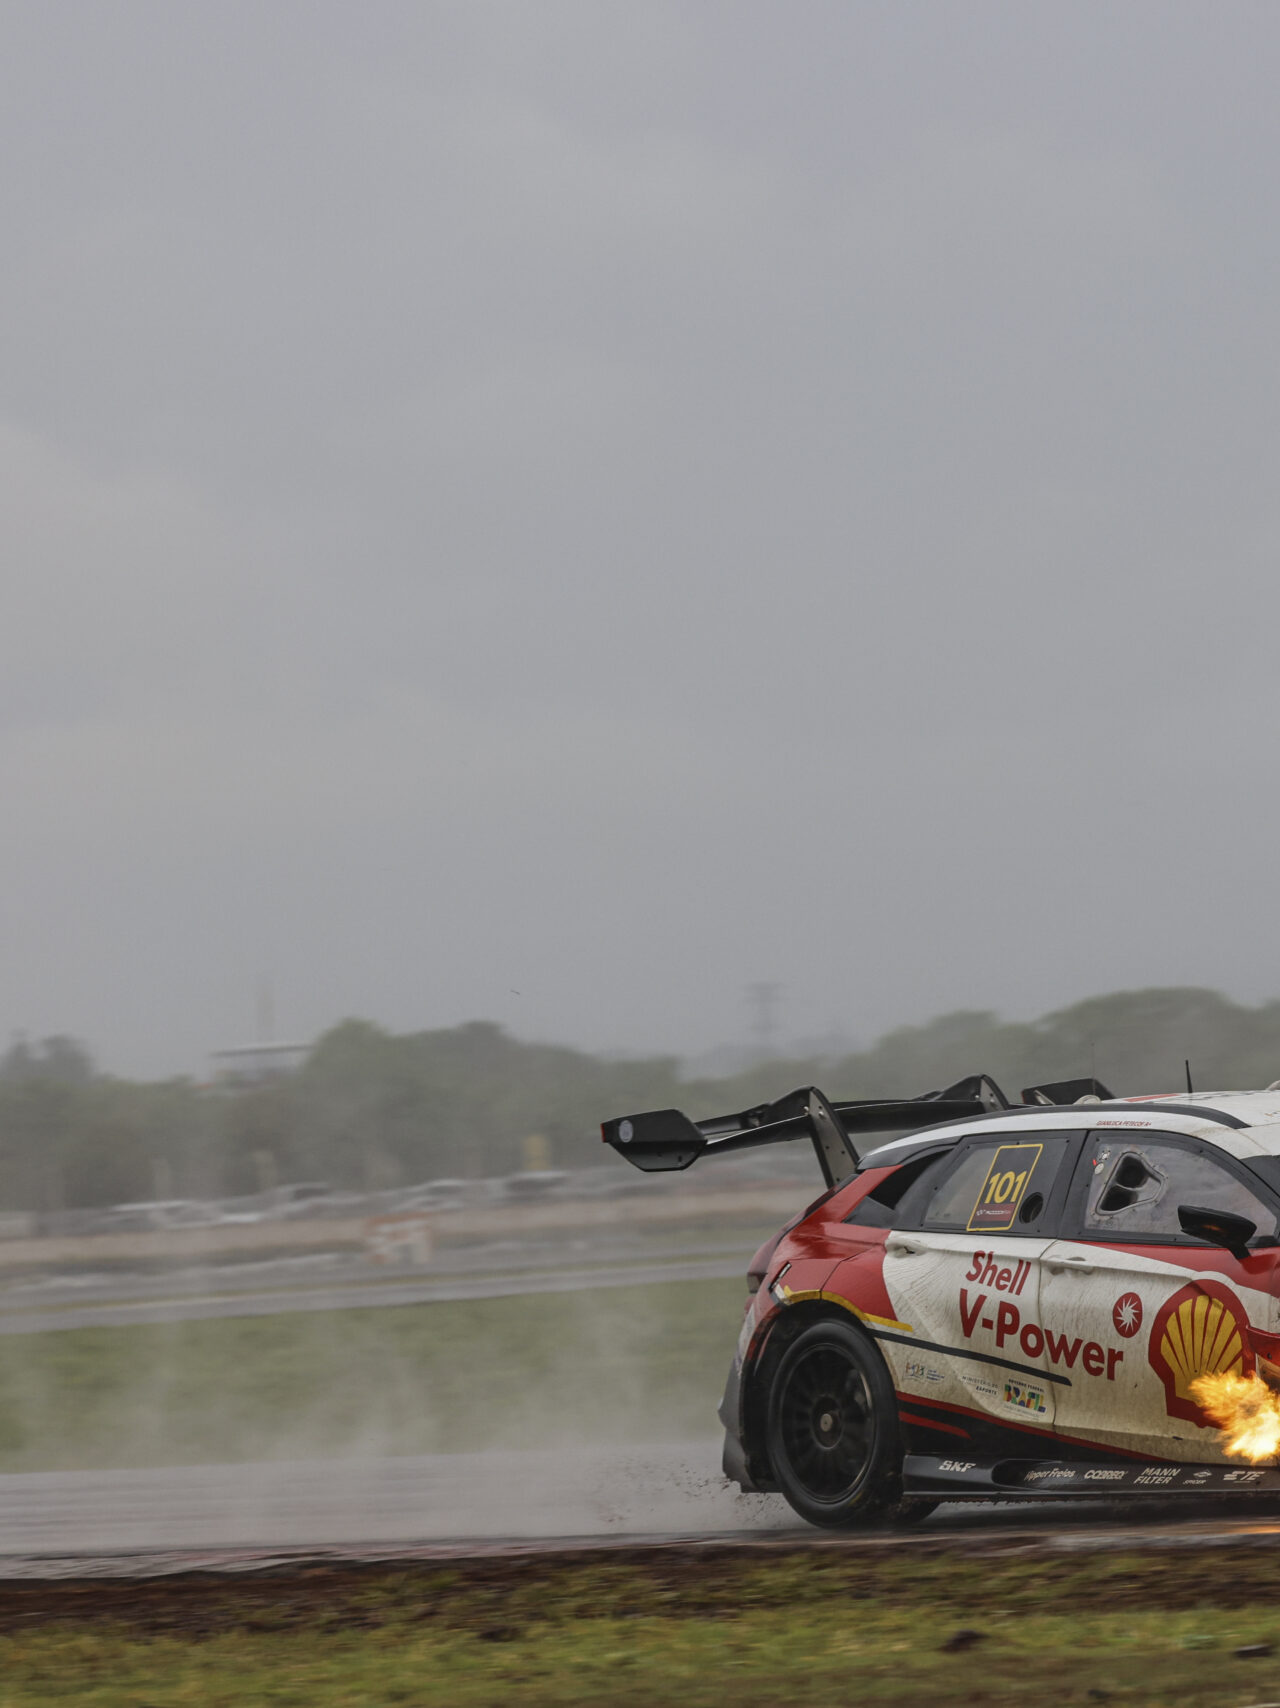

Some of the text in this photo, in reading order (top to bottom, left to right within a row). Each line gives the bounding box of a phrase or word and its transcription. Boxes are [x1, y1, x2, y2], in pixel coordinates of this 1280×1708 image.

[984, 1171, 1027, 1204] 101
[965, 1250, 1031, 1296] Shell
[959, 1288, 1124, 1381] V-Power
[1003, 1384, 1046, 1413] BRASIL
[939, 1460, 976, 1473] SKF
[1134, 1476, 1172, 1485] FILTER
[1142, 1468, 1181, 1477] MANN
